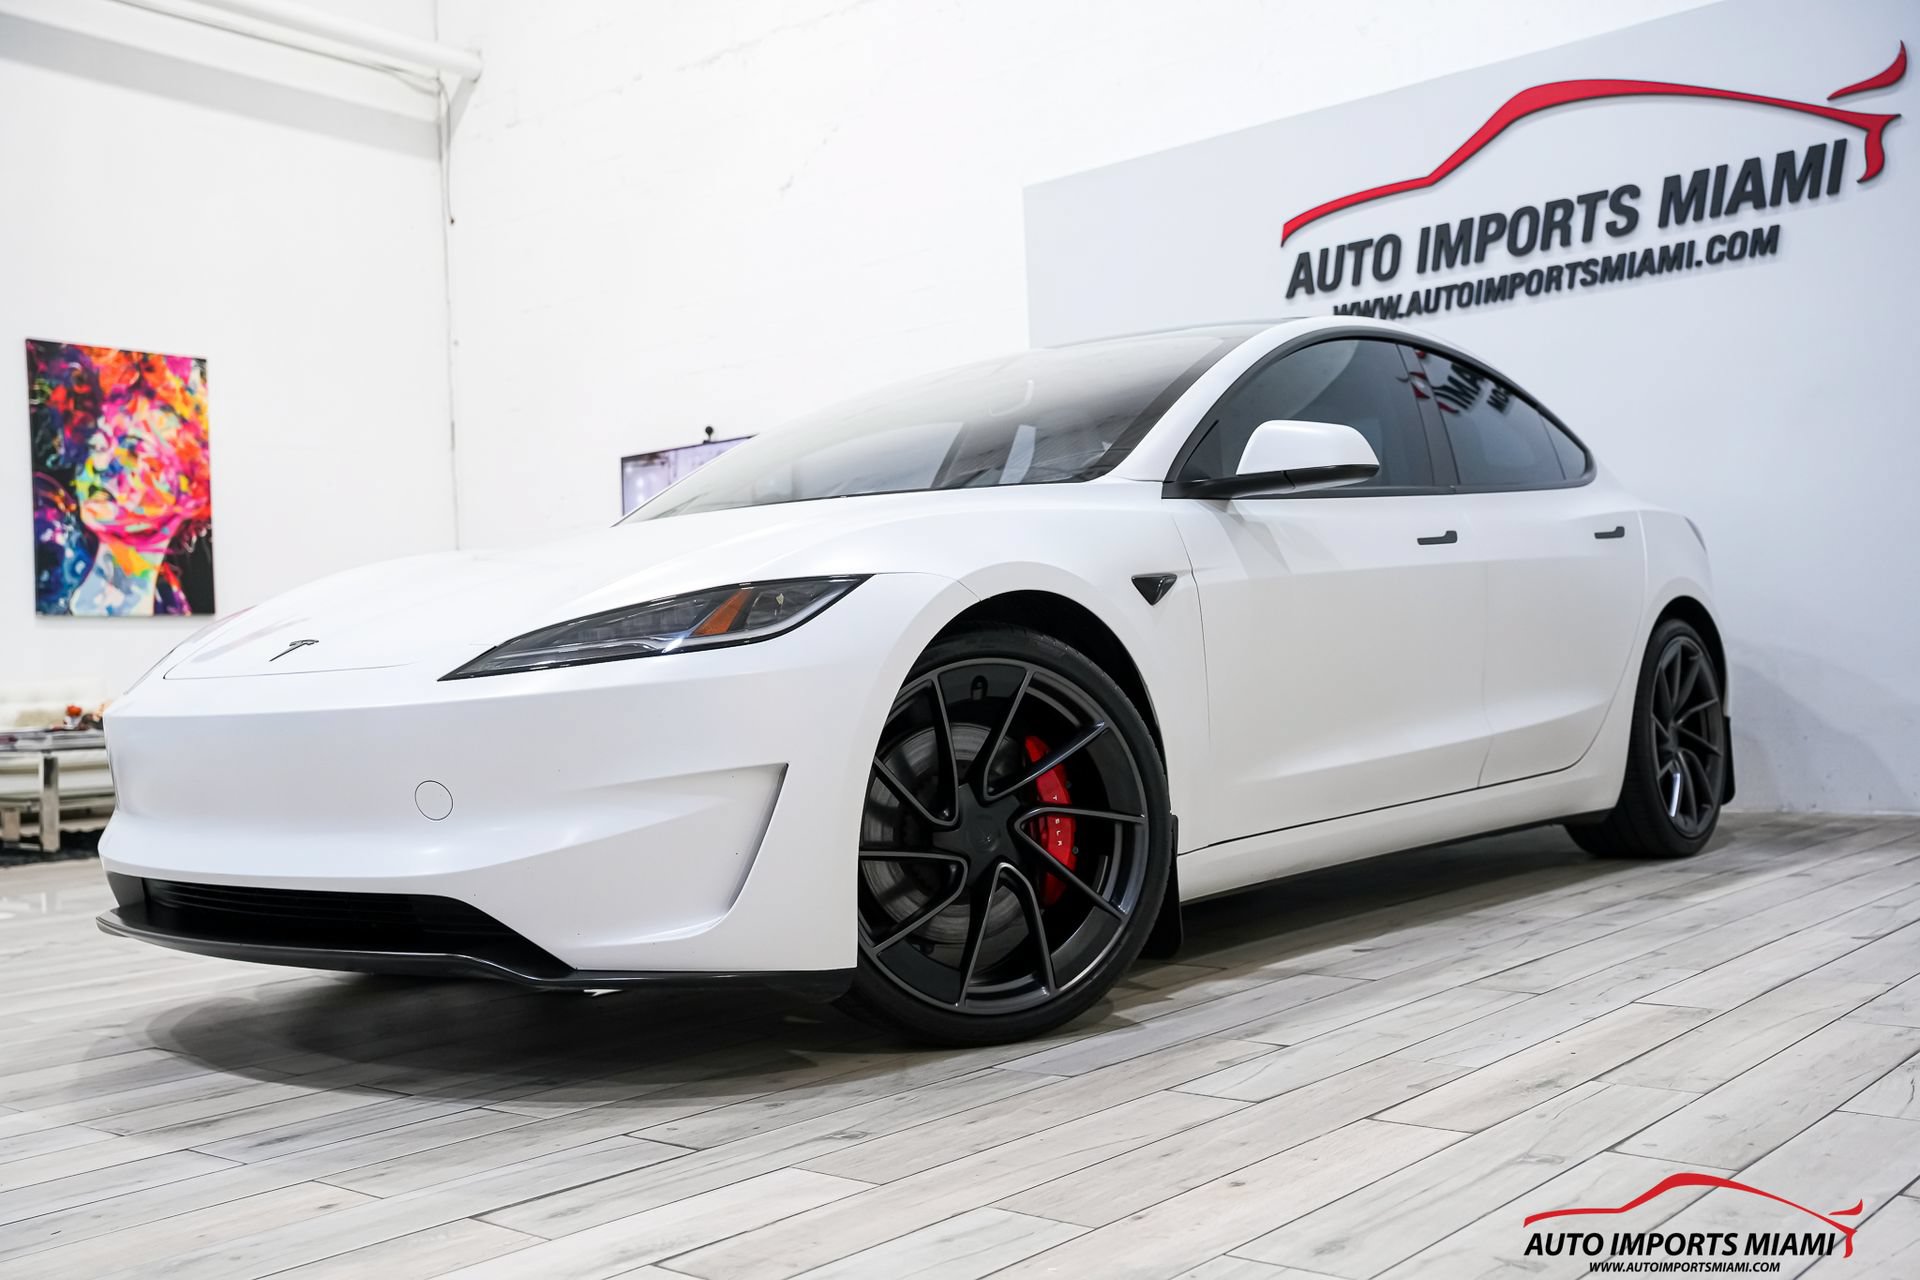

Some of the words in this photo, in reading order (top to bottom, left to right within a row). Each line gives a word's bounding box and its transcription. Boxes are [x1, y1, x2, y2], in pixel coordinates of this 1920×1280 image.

[1286, 234, 1402, 300] AUTO
[1416, 184, 1641, 274] IMPORTS
[1658, 138, 1848, 229] MIAMI
[1333, 224, 1781, 321] WWW.AUTOIMPORTSMIAMI.COM
[1052, 795, 1062, 846] TSLA
